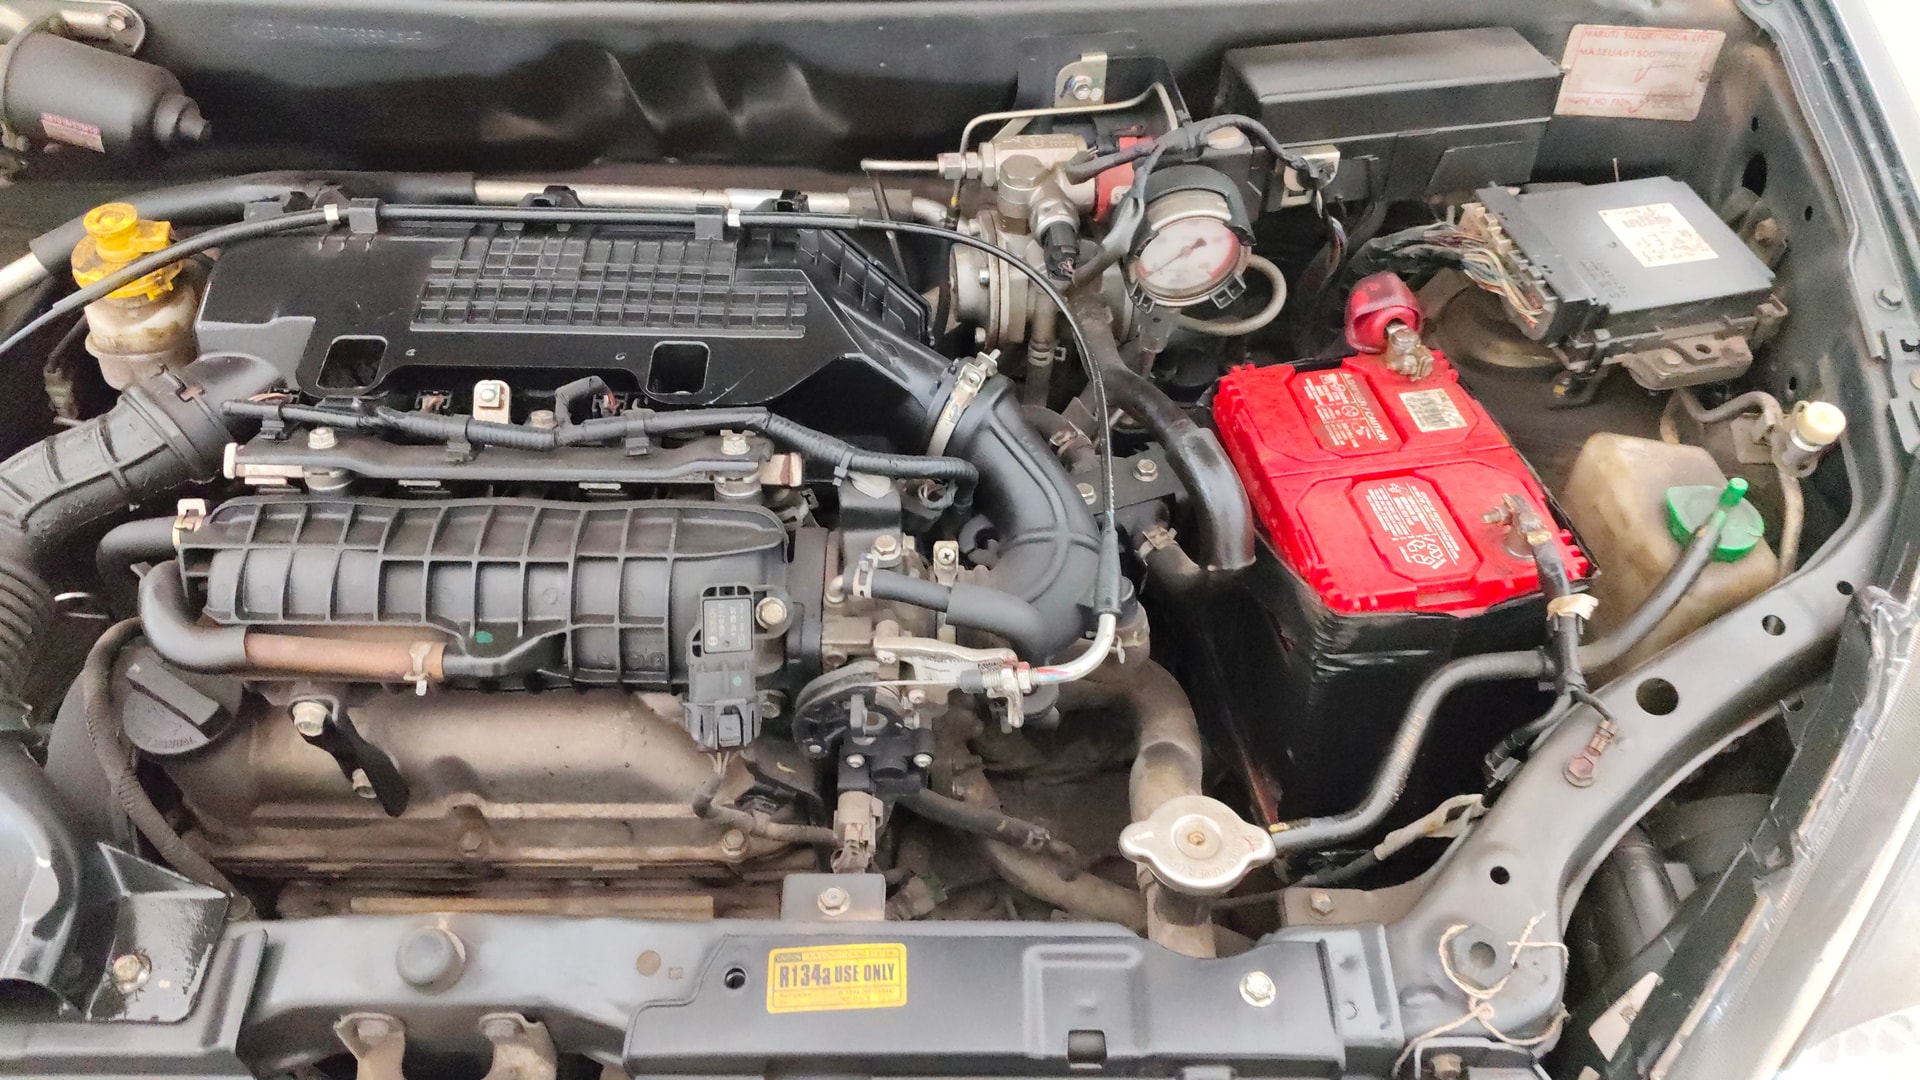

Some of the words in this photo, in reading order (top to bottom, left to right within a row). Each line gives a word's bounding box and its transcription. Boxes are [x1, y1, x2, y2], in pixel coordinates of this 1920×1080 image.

[1584, 29, 1619, 40] MARUTI
[1623, 30, 1656, 41] SUZUKI
[1662, 31, 1688, 41] INDIA
[779, 964, 831, 988] R134a
[834, 965, 859, 983] USE
[863, 963, 895, 982] ONLY
